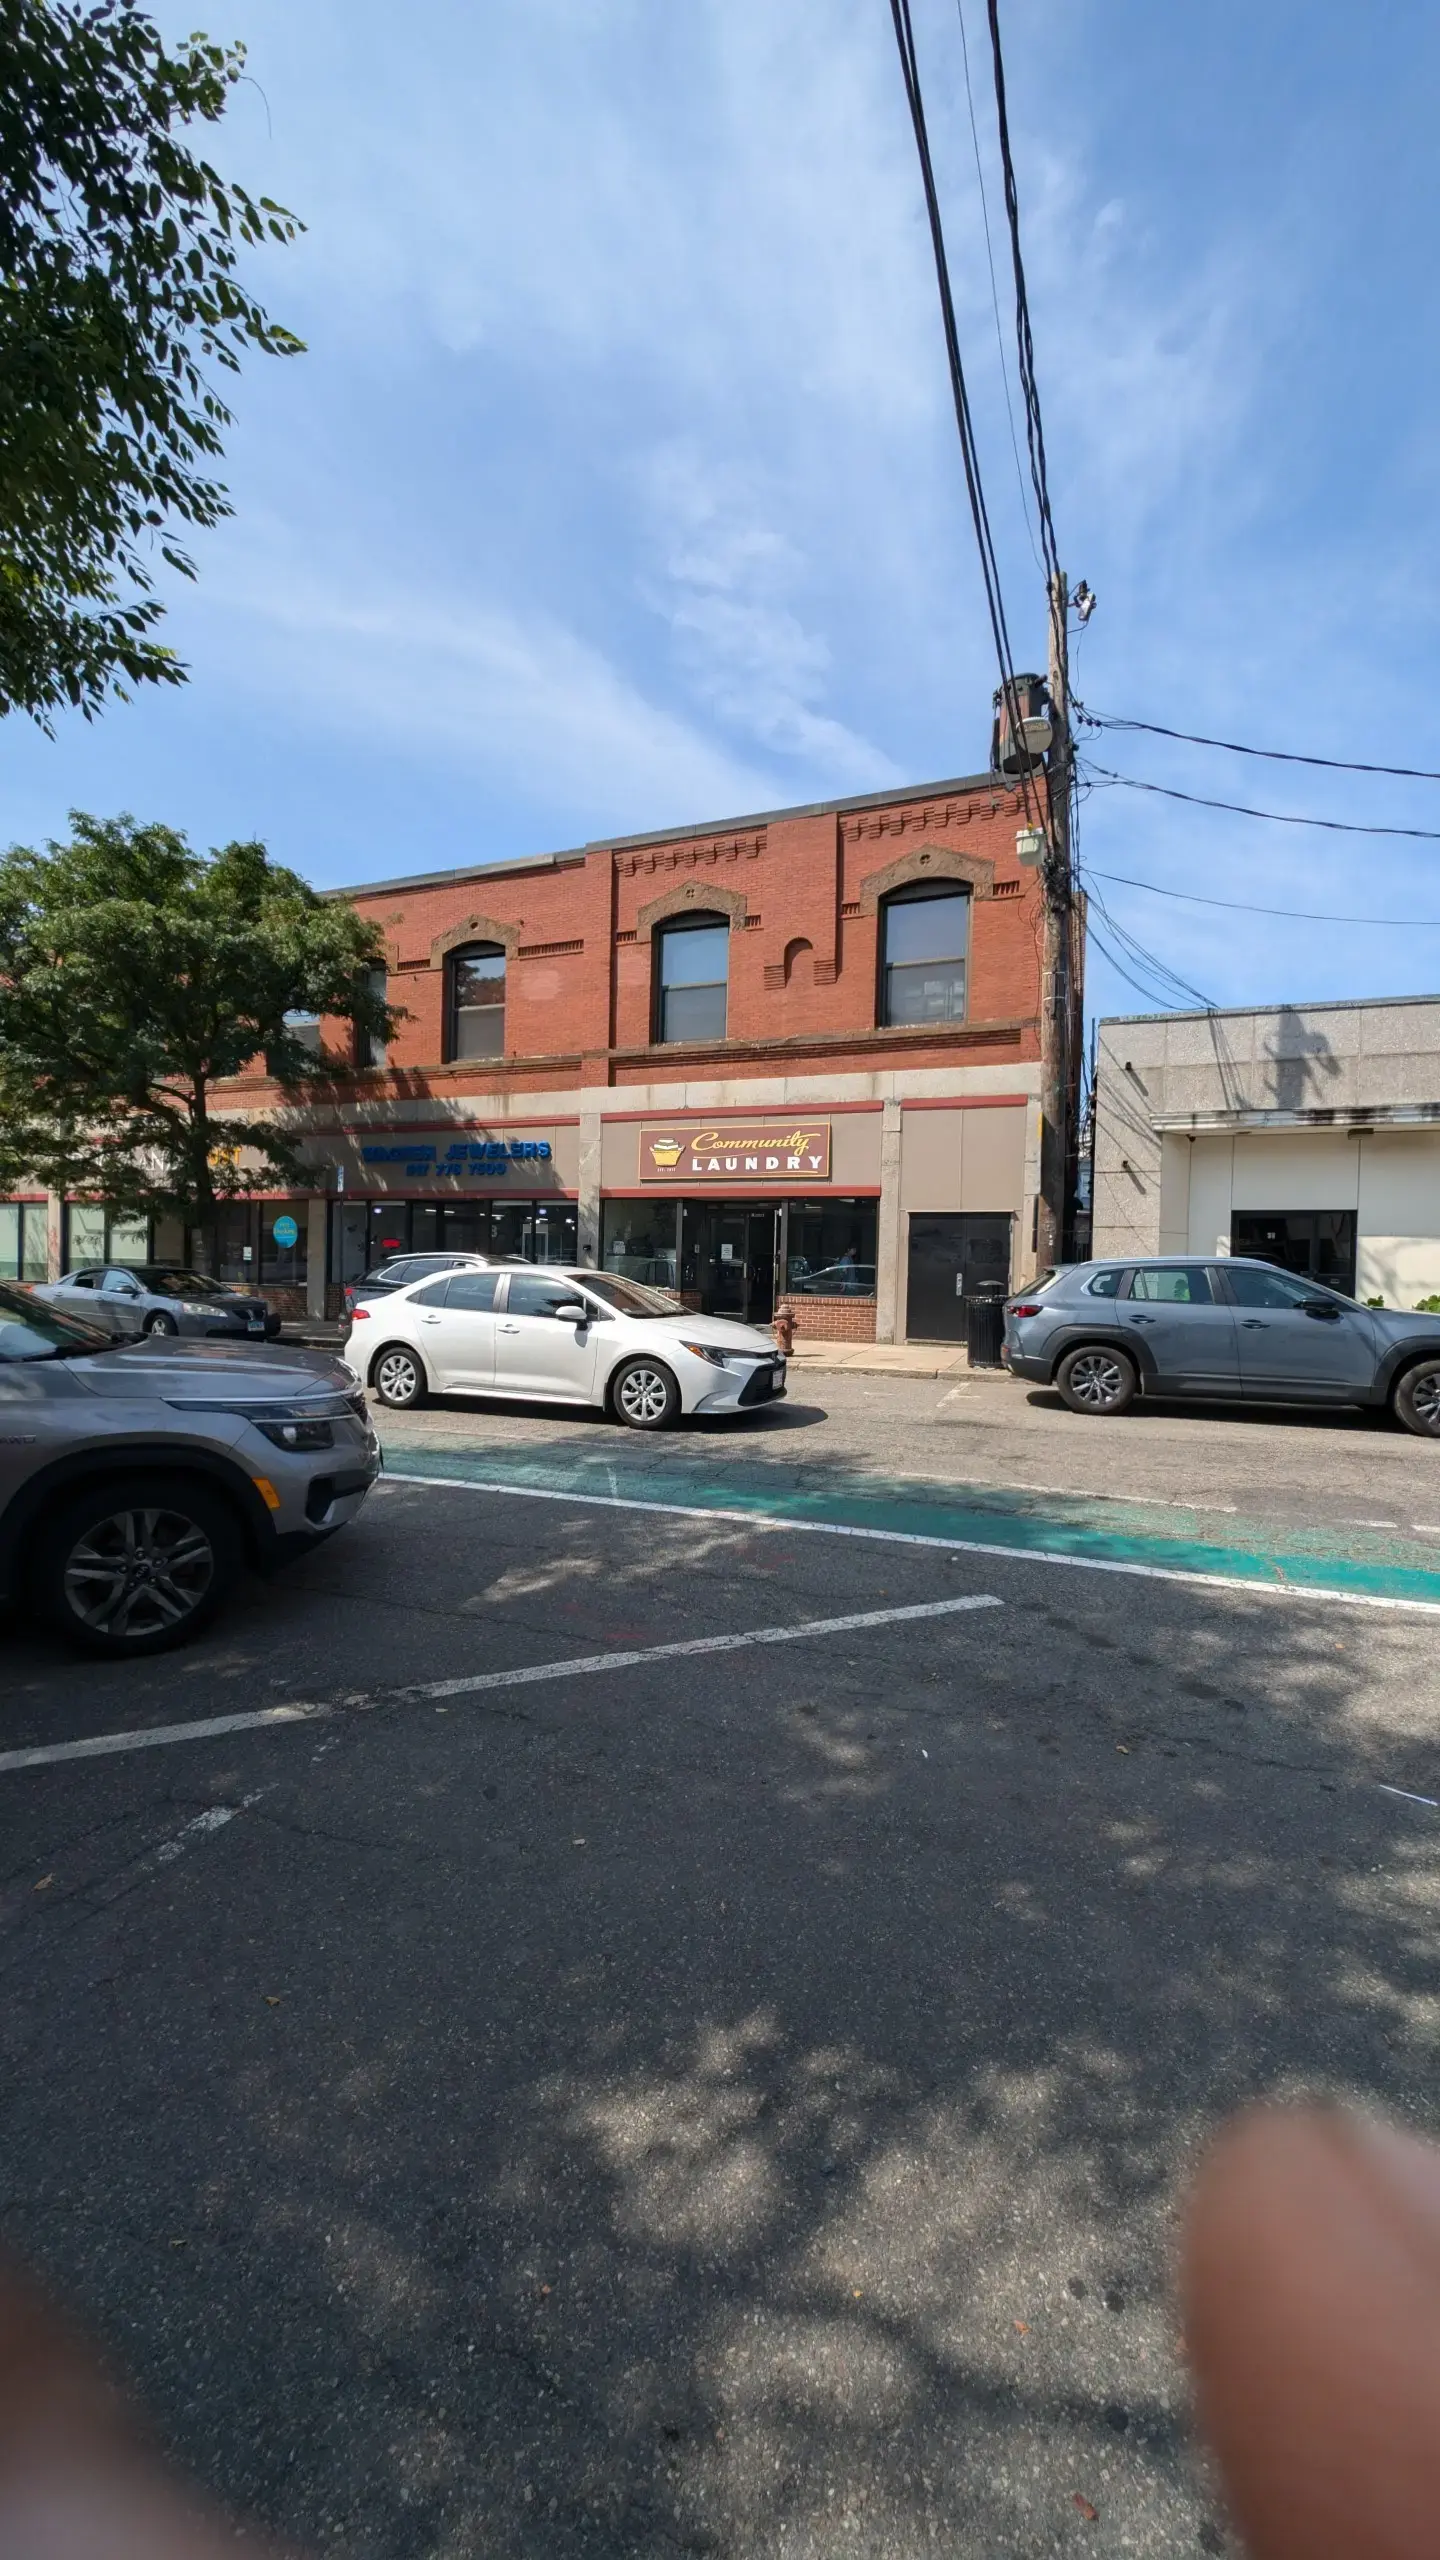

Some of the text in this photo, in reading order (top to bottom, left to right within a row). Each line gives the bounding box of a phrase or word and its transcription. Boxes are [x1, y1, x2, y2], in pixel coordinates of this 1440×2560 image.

[444, 1141, 552, 1162] JEWELERS
[690, 1129, 821, 1157] Community
[691, 1155, 823, 1172] LAUNDRY
